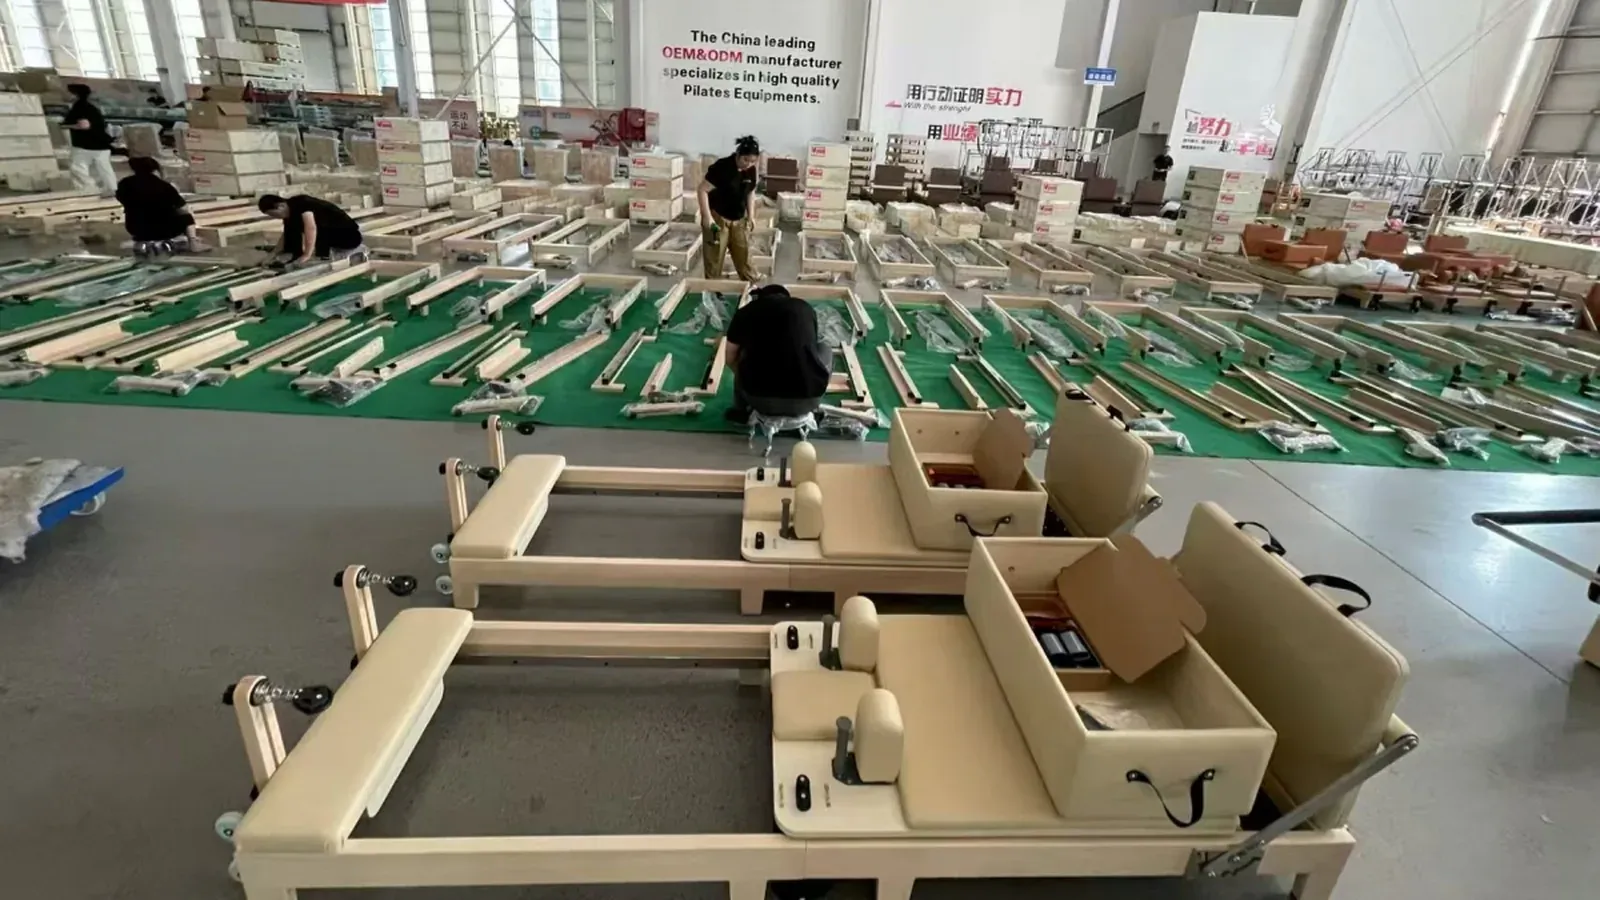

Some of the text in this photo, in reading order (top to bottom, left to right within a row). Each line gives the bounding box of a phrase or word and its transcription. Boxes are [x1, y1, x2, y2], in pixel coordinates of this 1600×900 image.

[690, 29, 816, 52] The China leading
[662, 46, 843, 70] OEM&ODM manufacturer
[662, 66, 840, 90] specializes in high quality
[683, 83, 821, 104] Pilates Equipments.
[906, 83, 1023, 107] 用行动证明实力
